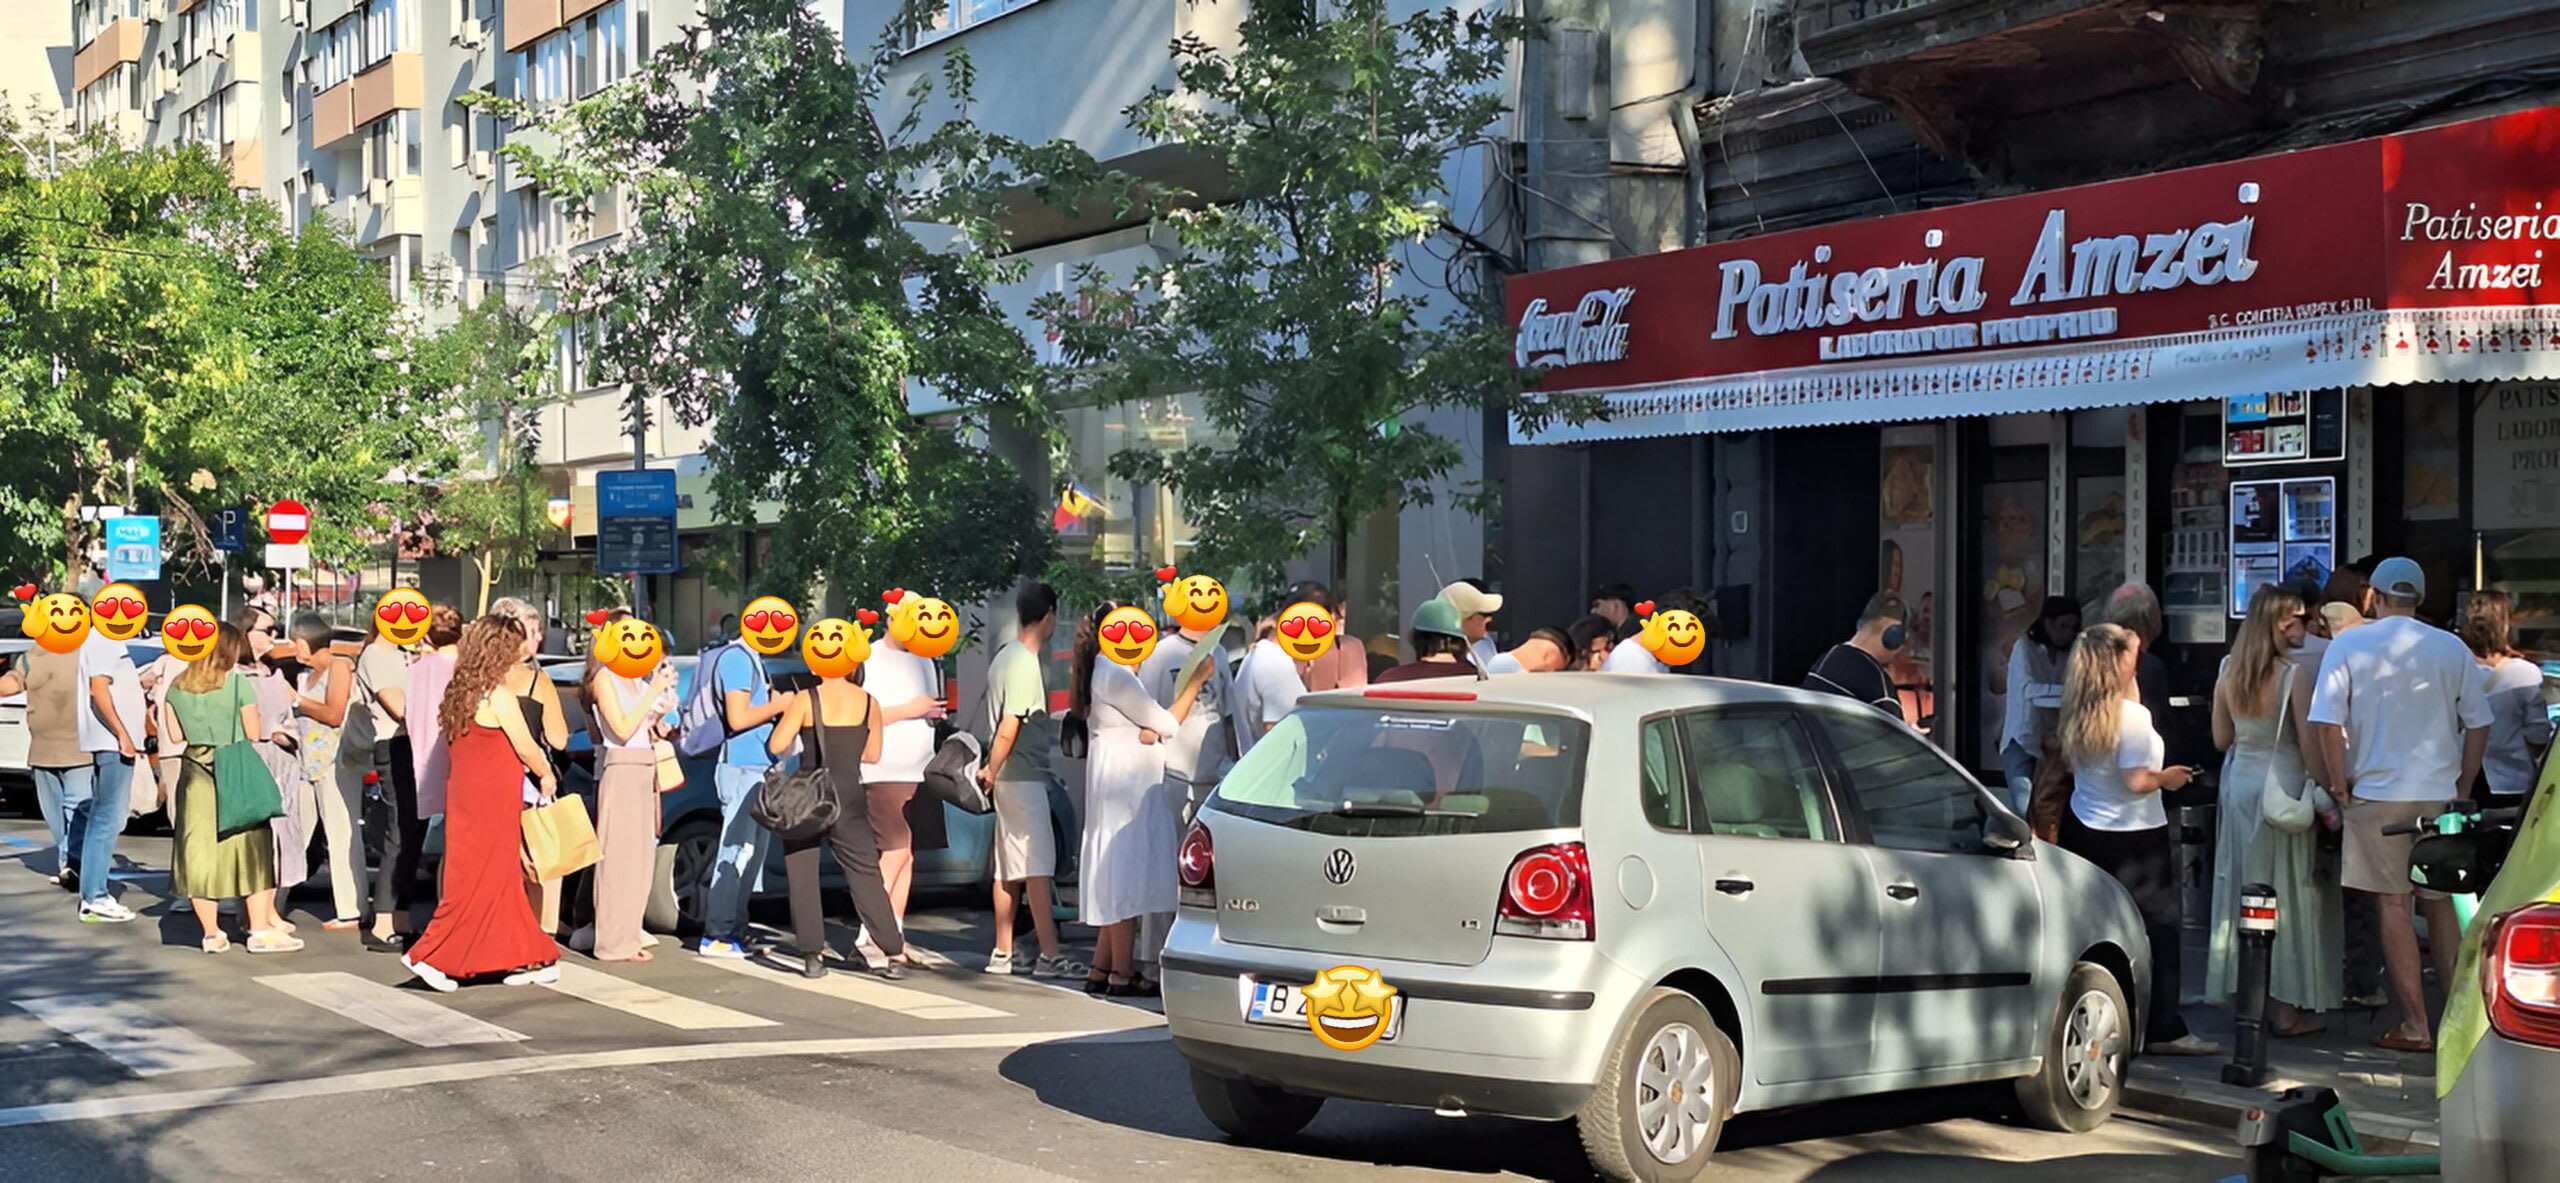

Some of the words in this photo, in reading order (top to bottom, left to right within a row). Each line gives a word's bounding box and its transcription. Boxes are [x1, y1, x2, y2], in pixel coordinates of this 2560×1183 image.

[1711, 229, 1987, 340] Patiseria
[2010, 182, 2260, 306] Amzei
[2426, 250, 2543, 290] Amzei
[1981, 307, 2118, 346] PROPRIU
[1270, 984, 1289, 1013] B
